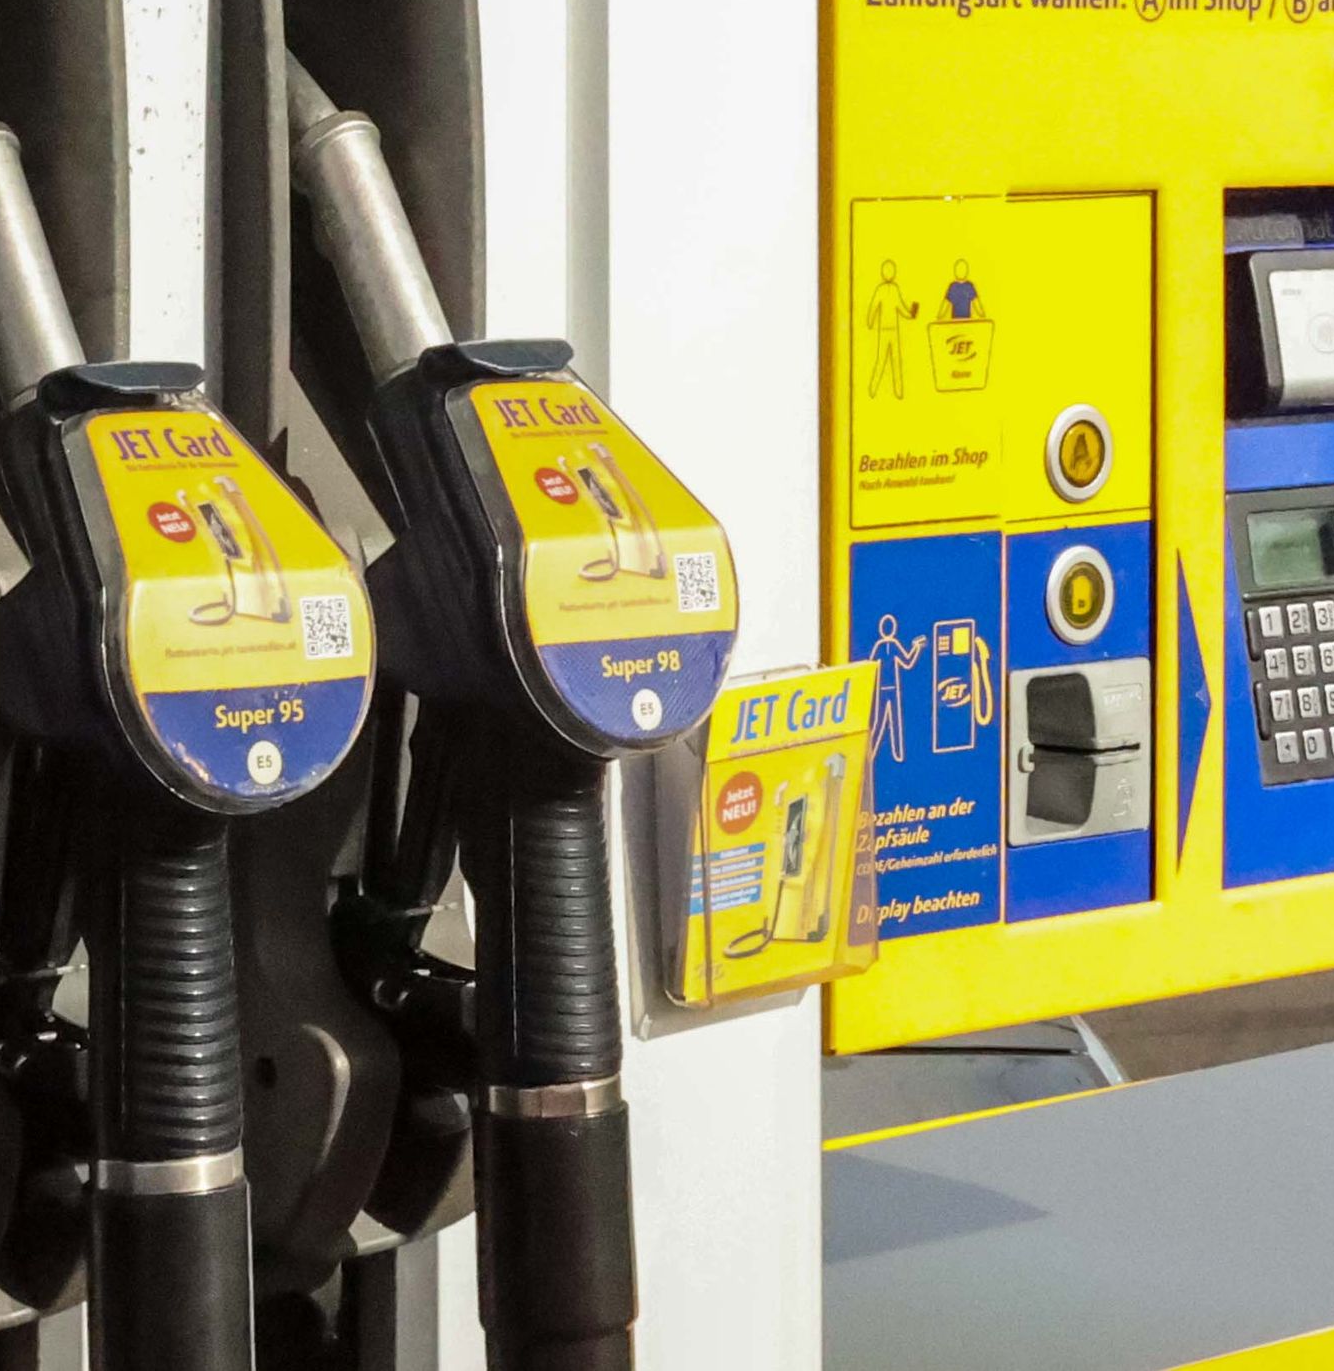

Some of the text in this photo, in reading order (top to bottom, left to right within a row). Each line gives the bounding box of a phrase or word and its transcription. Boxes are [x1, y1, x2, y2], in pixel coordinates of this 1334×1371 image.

[949, 341, 973, 355] JET
[493, 397, 601, 427] JET Card
[110, 427, 232, 460] JET Card
[859, 447, 988, 473] Bezahlen im Shop
[601, 649, 681, 683] Super 98
[941, 684, 967, 701] JET
[215, 698, 304, 734] Super 95
[731, 679, 850, 744] JET Card
[257, 755, 272, 769] E5
[722, 799, 757, 823] NEU!
[928, 804, 946, 819] an
[949, 797, 976, 816] der
[913, 890, 980, 915] beachten
